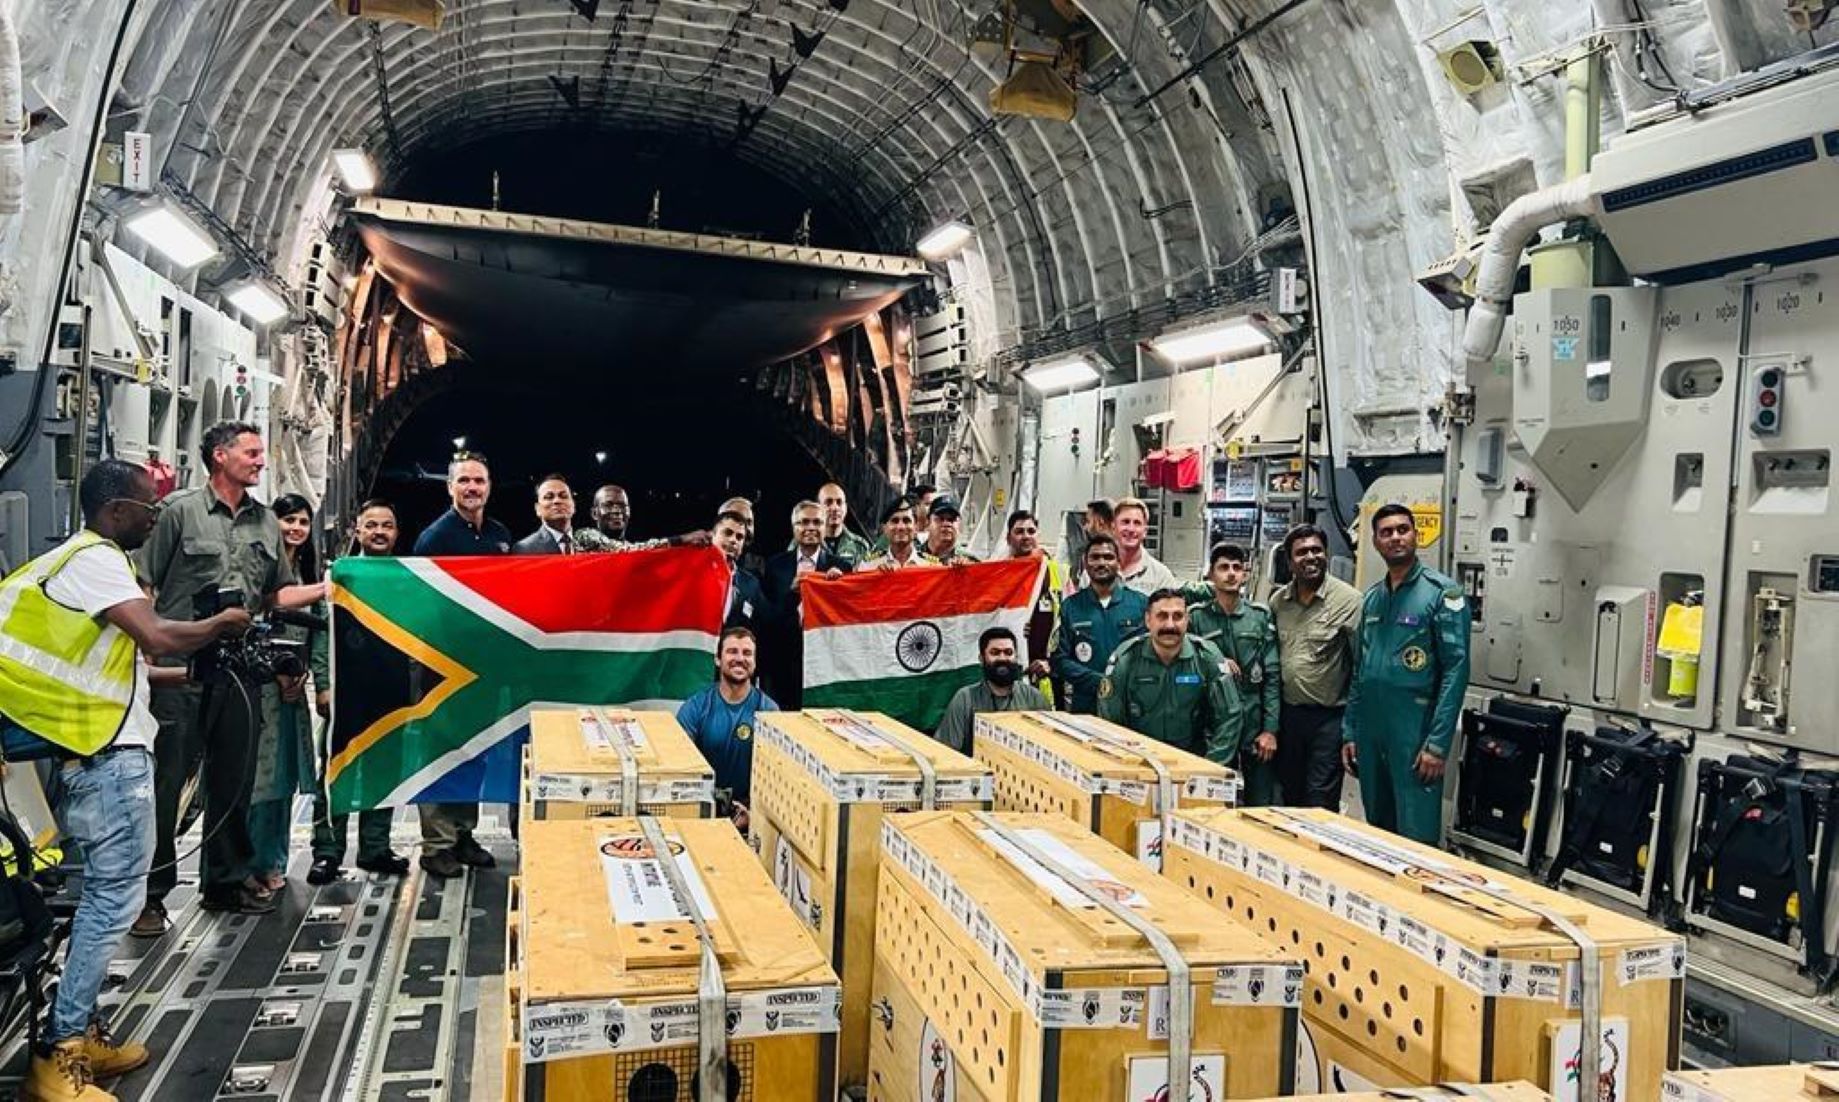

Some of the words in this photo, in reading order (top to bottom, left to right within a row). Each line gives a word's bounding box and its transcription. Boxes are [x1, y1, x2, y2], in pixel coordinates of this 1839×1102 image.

[133, 138, 141, 183] EXIT
[1777, 295, 1799, 311] 1020
[1554, 318, 1579, 332] 1050
[1415, 515, 1439, 529] GENCY
[768, 992, 820, 1006] INSPECTED
[531, 1013, 587, 1030] INSPECTED
